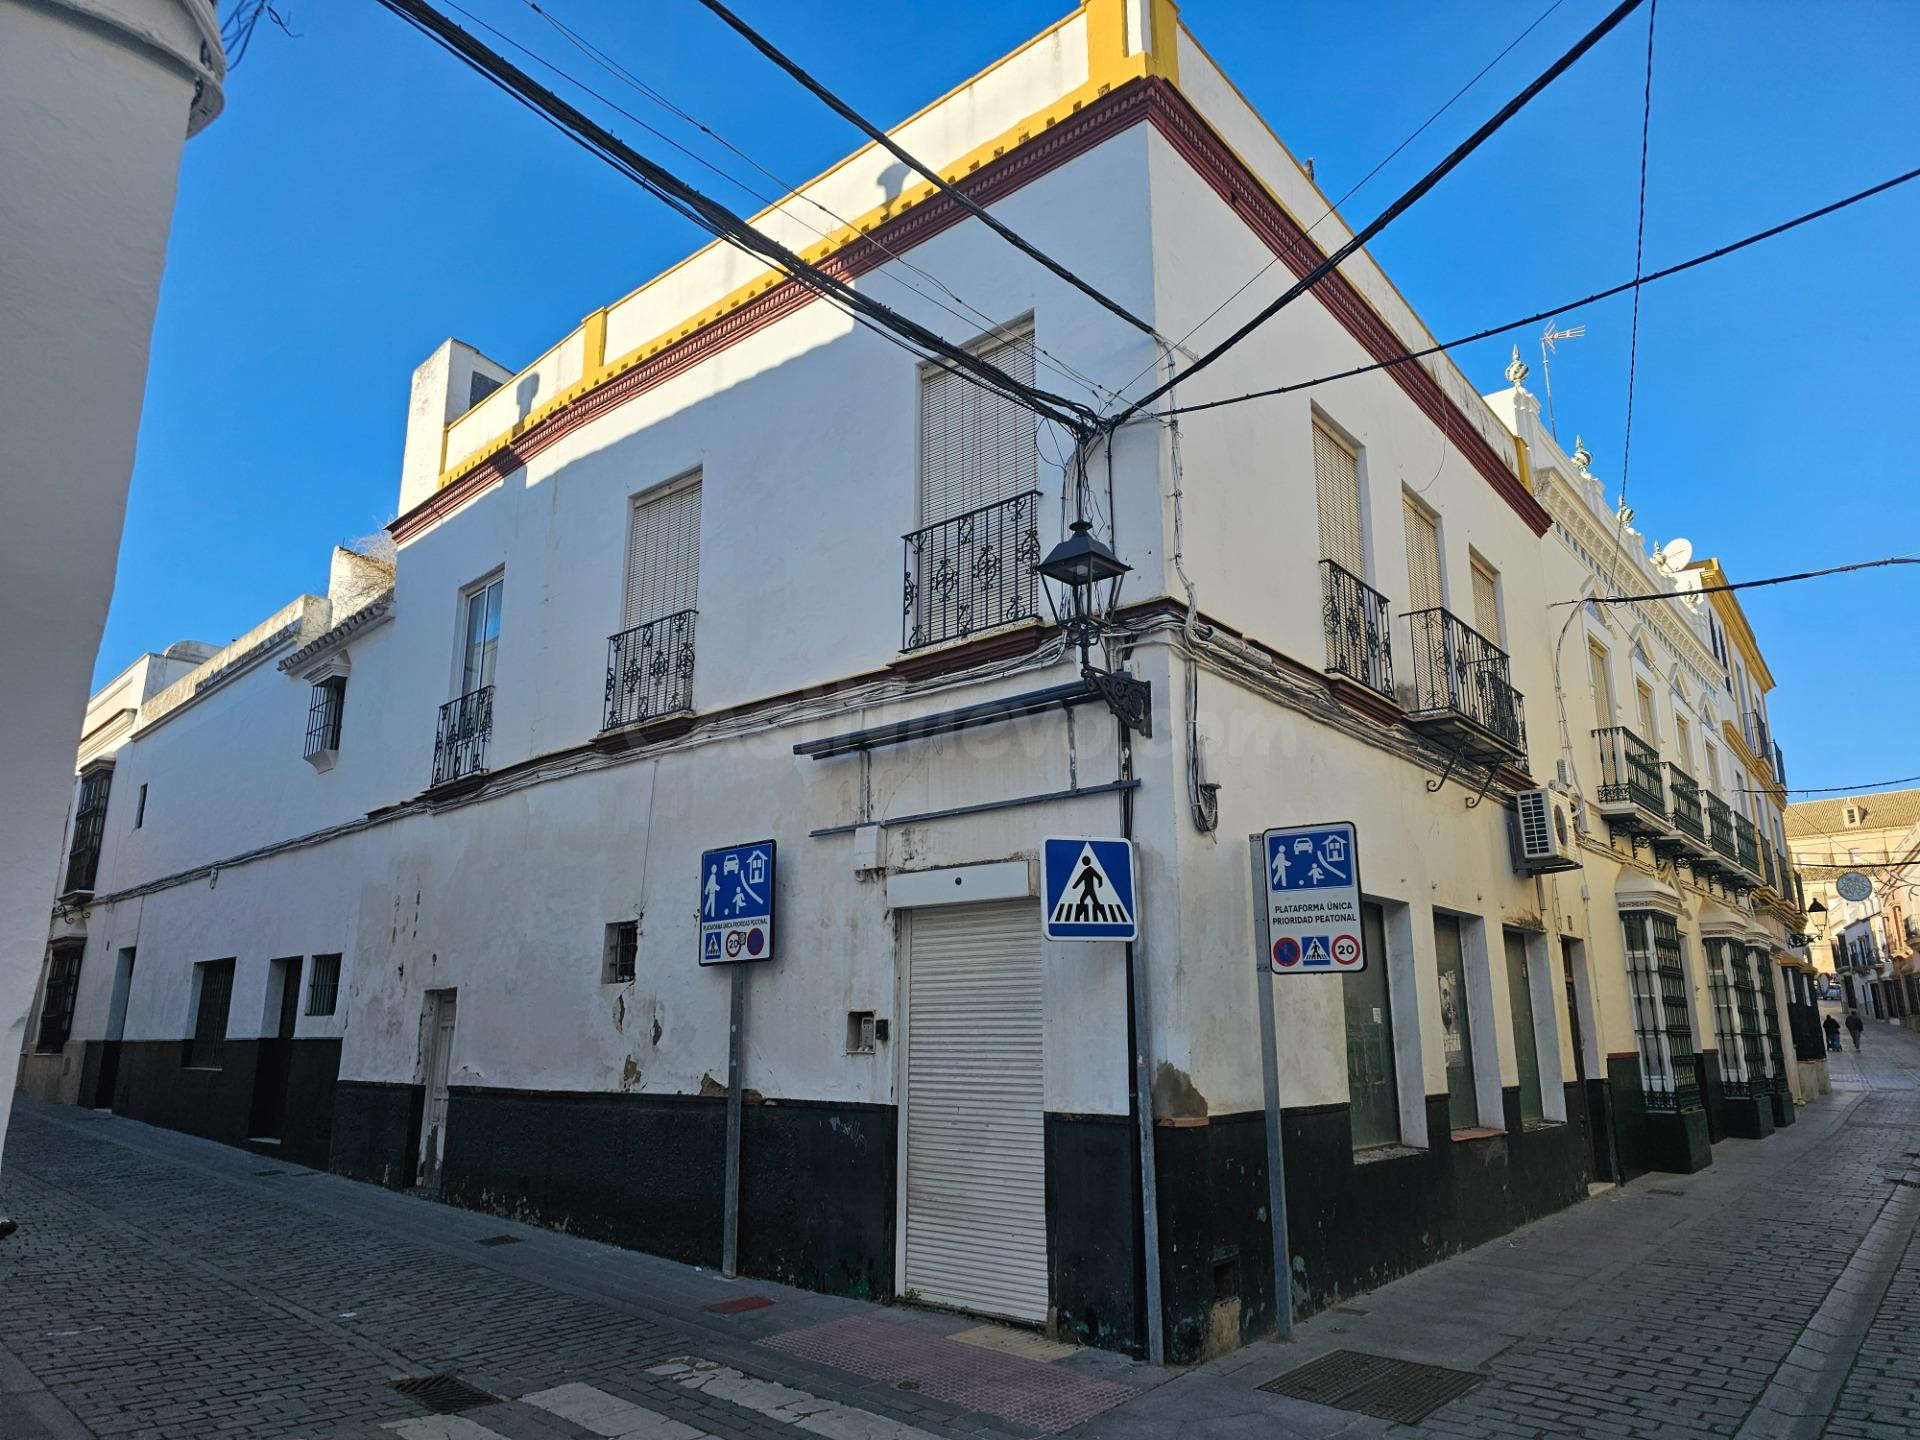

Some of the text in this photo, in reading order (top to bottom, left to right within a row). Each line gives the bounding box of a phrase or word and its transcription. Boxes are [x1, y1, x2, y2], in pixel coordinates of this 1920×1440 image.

[1275, 901, 1353, 914] PLATAFORMA ÚNICA
[1272, 913, 1357, 925] PRIORIDAD PEATONAL
[729, 939, 740, 949] 20
[1337, 944, 1355, 955] 20
